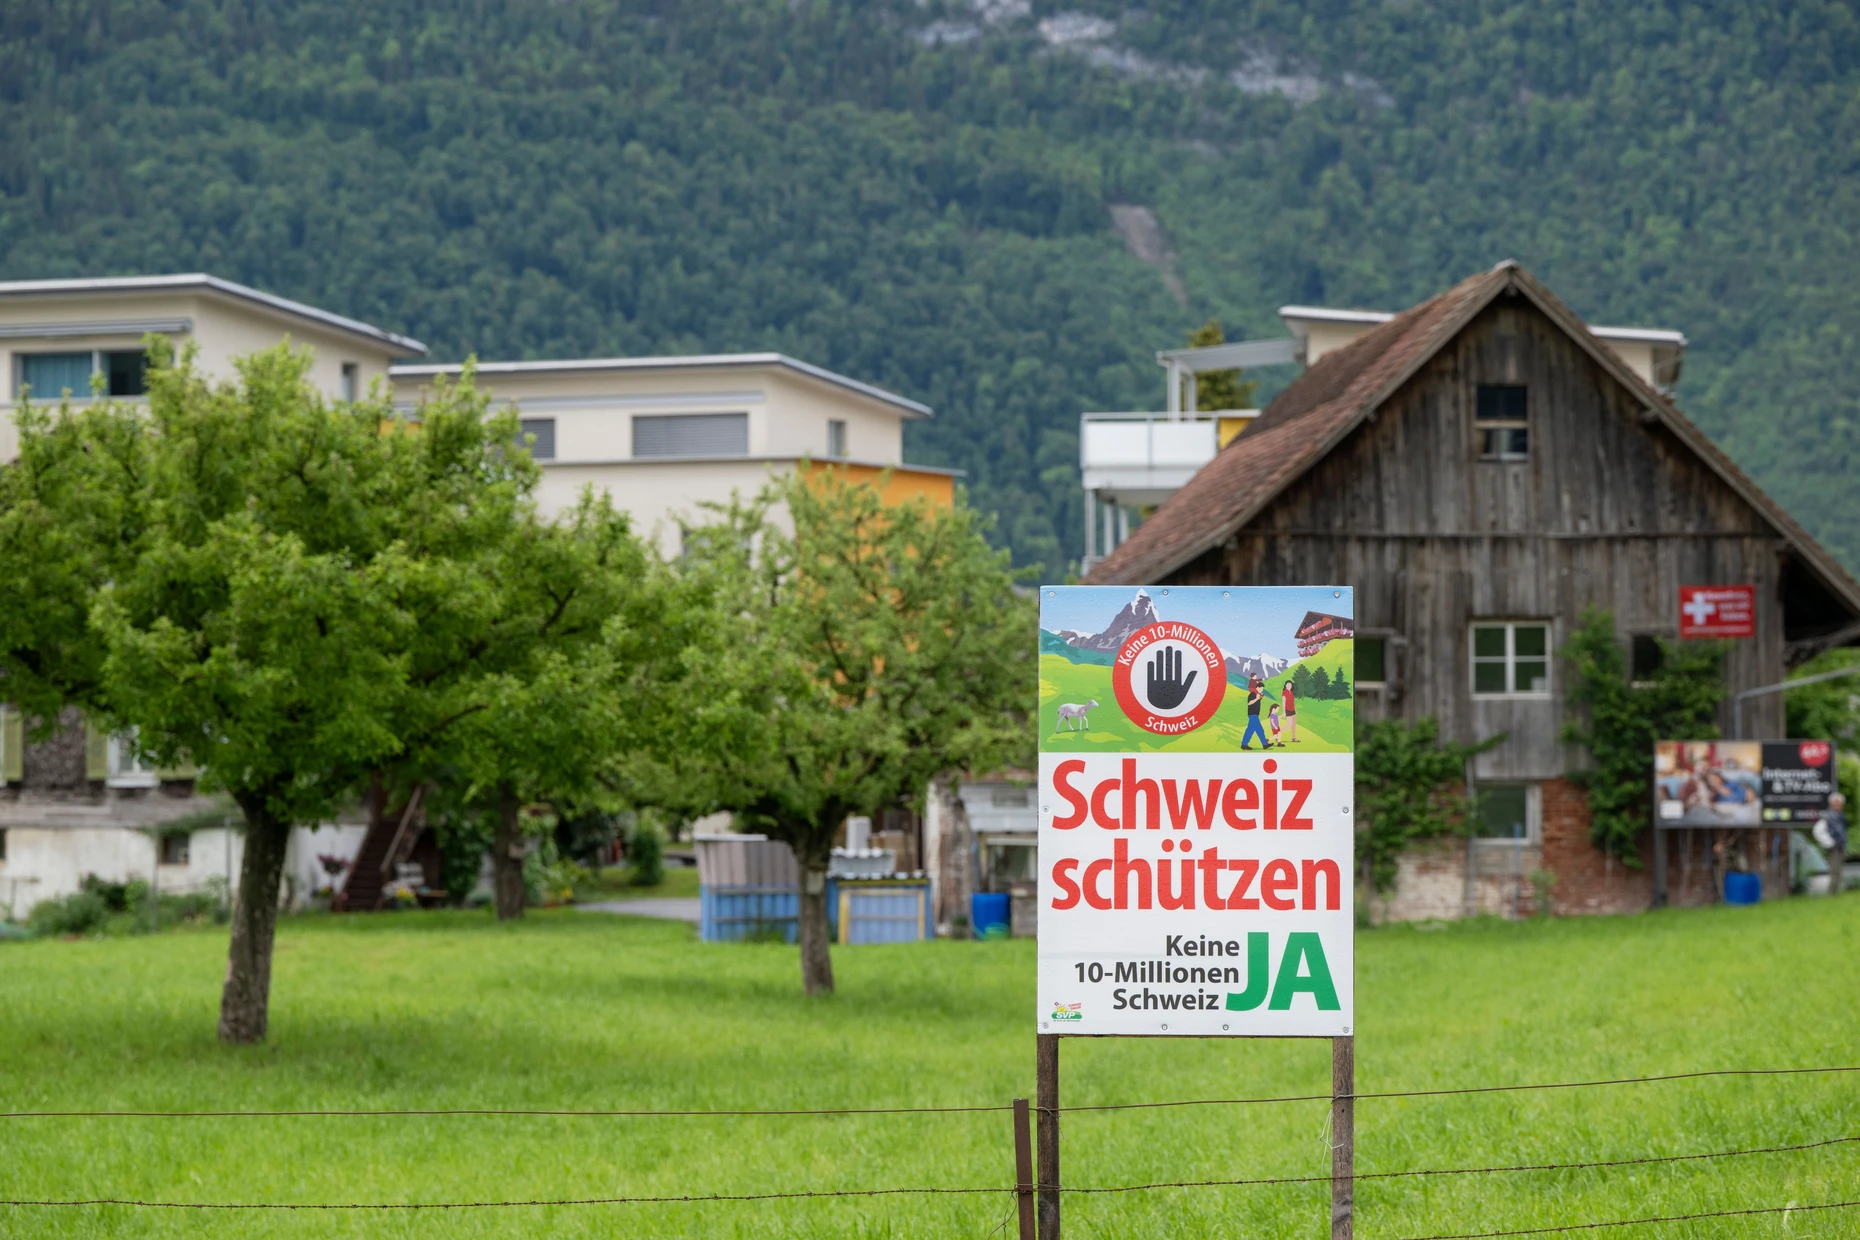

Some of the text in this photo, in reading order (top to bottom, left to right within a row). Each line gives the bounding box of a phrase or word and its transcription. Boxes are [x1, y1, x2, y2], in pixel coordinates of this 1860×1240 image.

[1118, 624, 1220, 669] Keine 10-Millionen
[1144, 715, 1199, 733] Schweiz
[1052, 758, 1313, 830] Schweiz
[1051, 838, 1341, 911] schützen
[1166, 934, 1240, 957] Keine
[1075, 961, 1239, 984] 10-Millionen
[1225, 932, 1341, 1012] JA
[1112, 987, 1220, 1011] Schweiz
[1056, 1011, 1076, 1019] SVP
